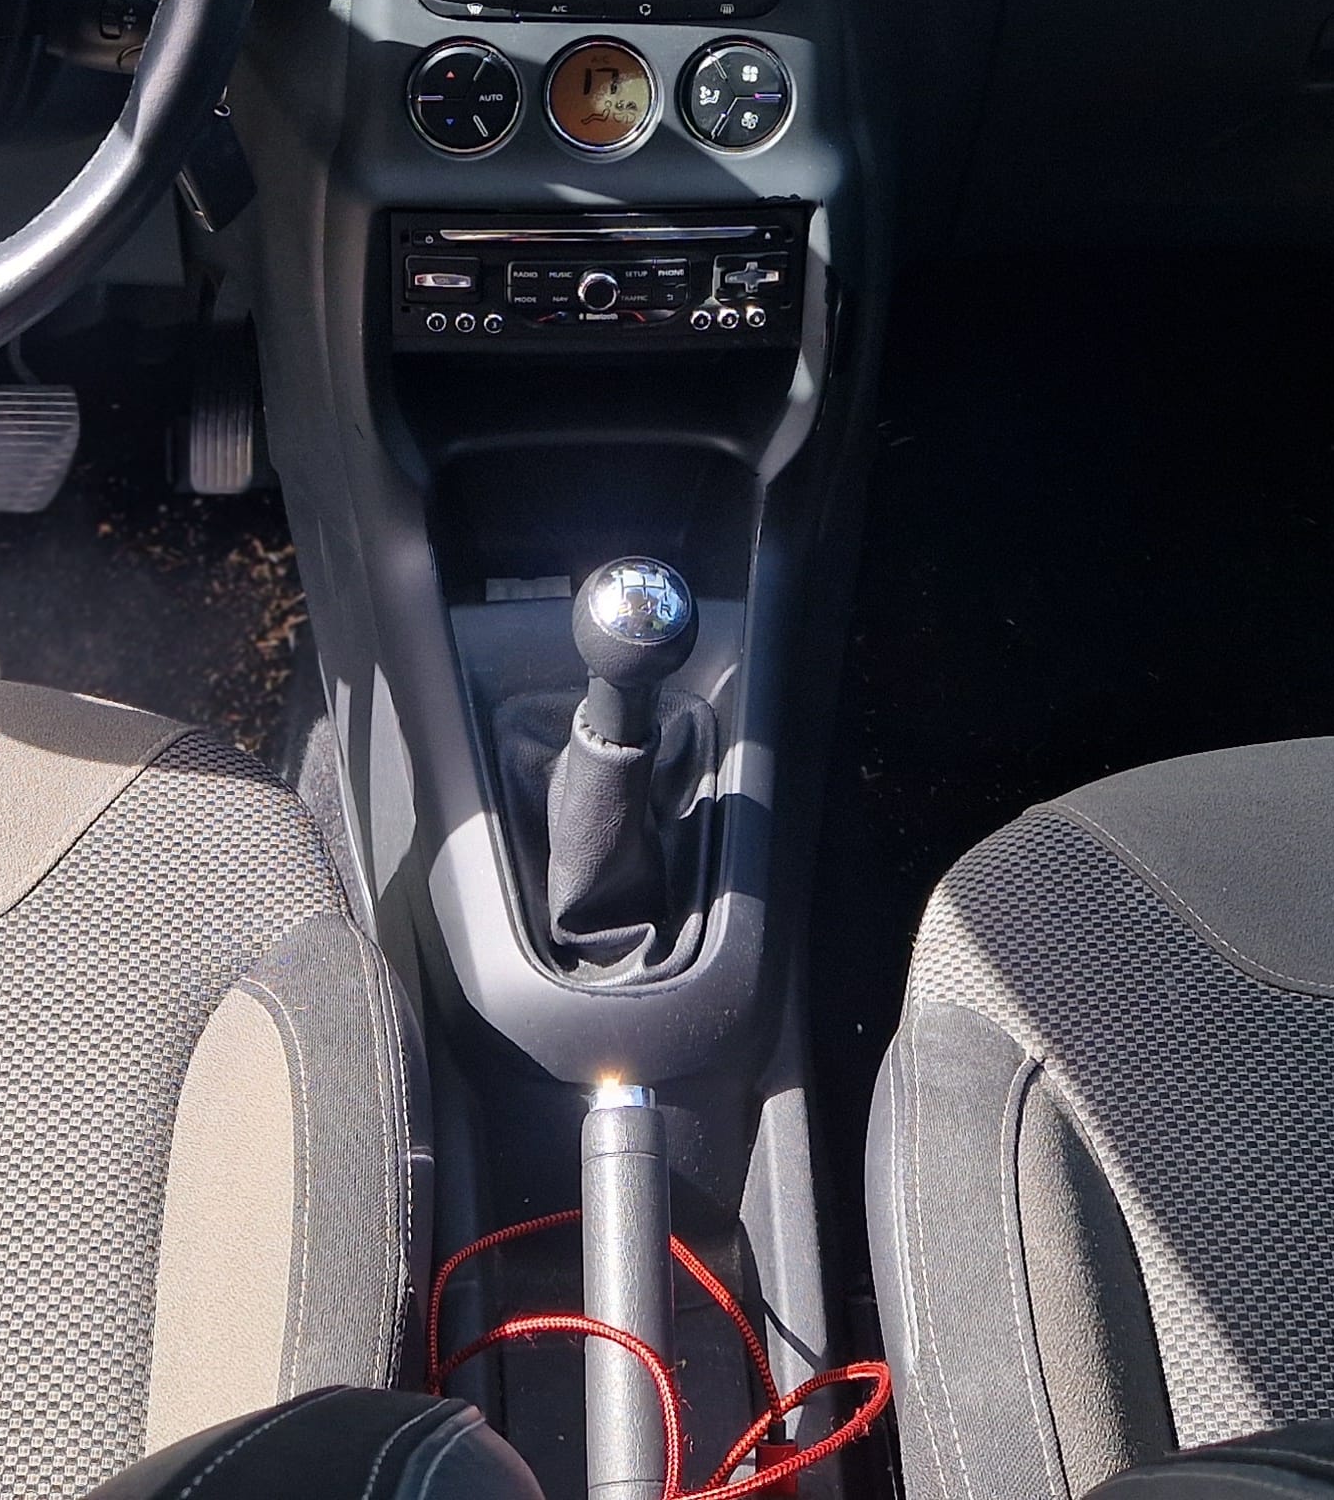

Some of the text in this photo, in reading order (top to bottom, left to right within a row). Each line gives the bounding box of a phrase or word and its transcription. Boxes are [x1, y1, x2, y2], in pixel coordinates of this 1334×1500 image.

[551, 4, 568, 13] A/C
[479, 93, 504, 102] AUTO
[513, 271, 539, 279] RADIO
